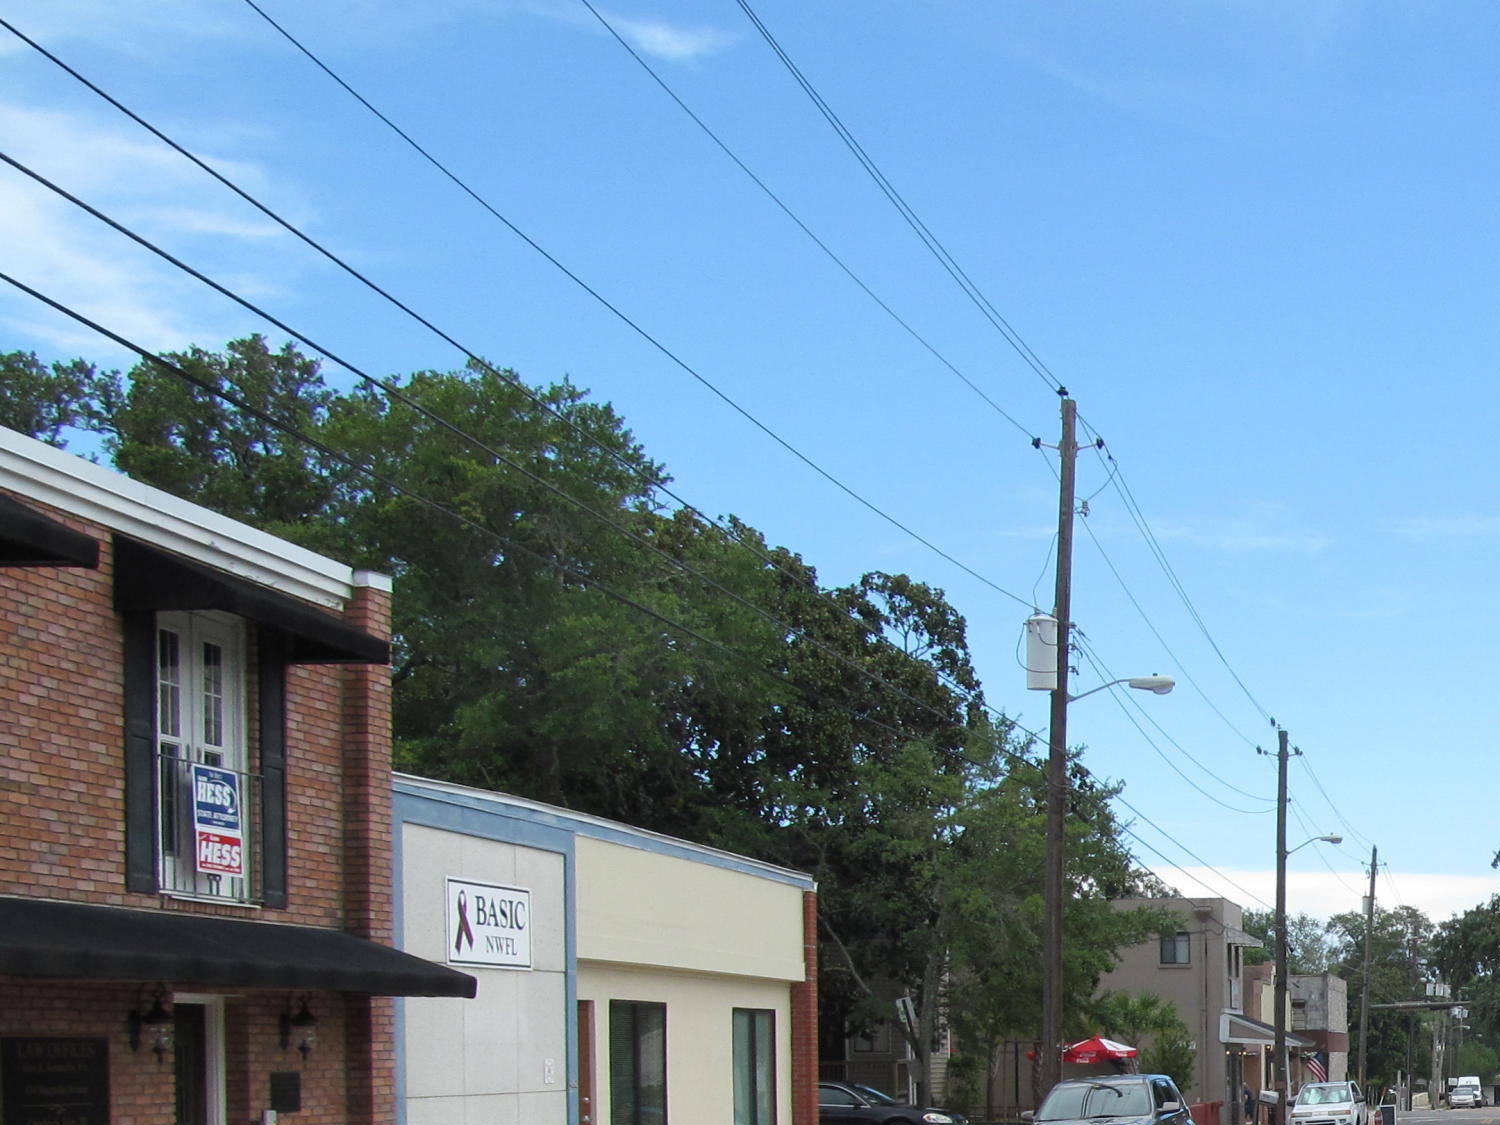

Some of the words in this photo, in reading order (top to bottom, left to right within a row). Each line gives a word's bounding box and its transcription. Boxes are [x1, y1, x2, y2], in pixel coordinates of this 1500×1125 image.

[197, 781, 231, 807] HESS
[200, 841, 241, 868] HESS
[475, 895, 526, 930] BASIC
[485, 935, 518, 956] NWFL
